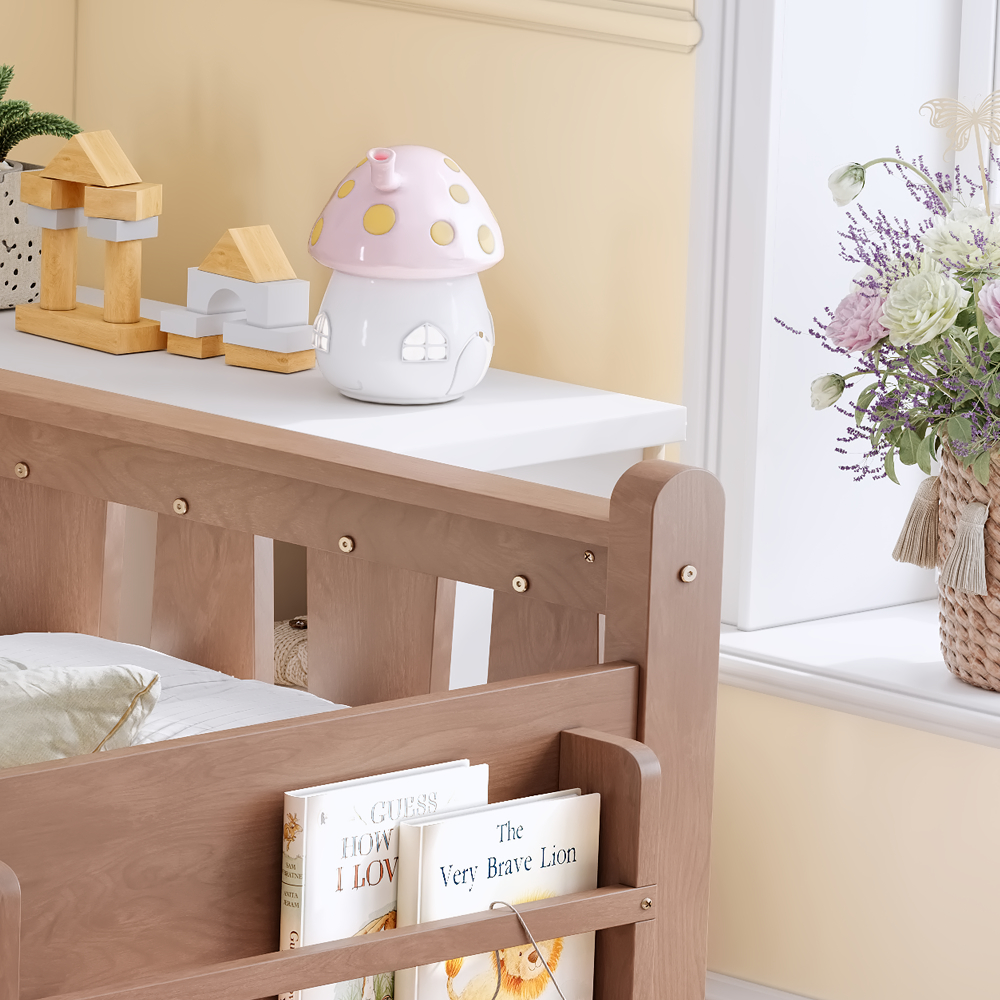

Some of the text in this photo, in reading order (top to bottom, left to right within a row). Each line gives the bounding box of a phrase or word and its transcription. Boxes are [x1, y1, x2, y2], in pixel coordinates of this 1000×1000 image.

[370, 791, 438, 825] GUESS
[341, 828, 394, 860] HOW
[496, 820, 524, 843] The
[335, 856, 399, 892] I LOV
[439, 845, 577, 892] Very Brave Lion
